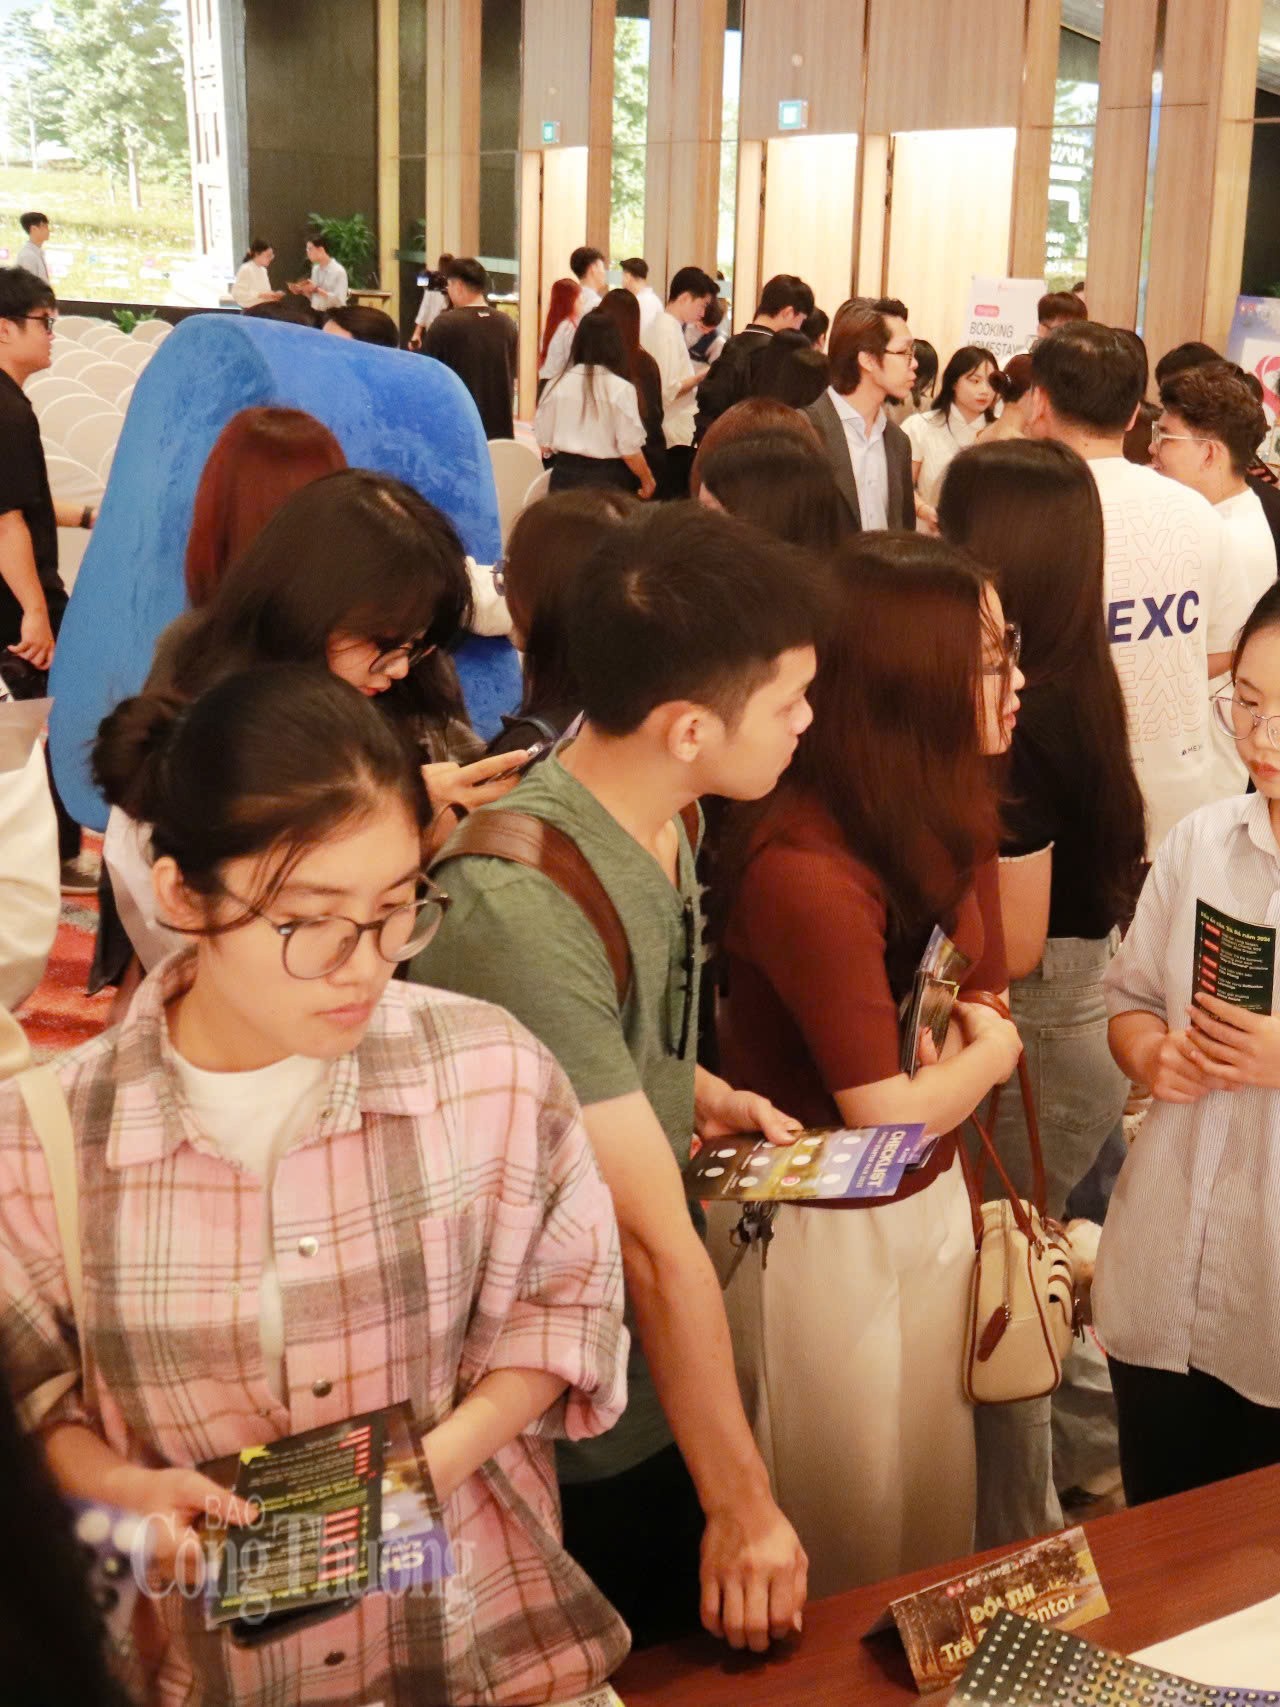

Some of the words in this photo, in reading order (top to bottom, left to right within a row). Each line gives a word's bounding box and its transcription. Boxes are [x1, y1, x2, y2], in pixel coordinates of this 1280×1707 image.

[969, 321, 1014, 338] BOOKING
[1107, 590, 1200, 644] EXC
[867, 1130, 906, 1188] CHECKLIST
[1005, 1583, 1037, 1610] THI
[940, 1631, 975, 1663] Trà
[1027, 1592, 1077, 1624] entor
